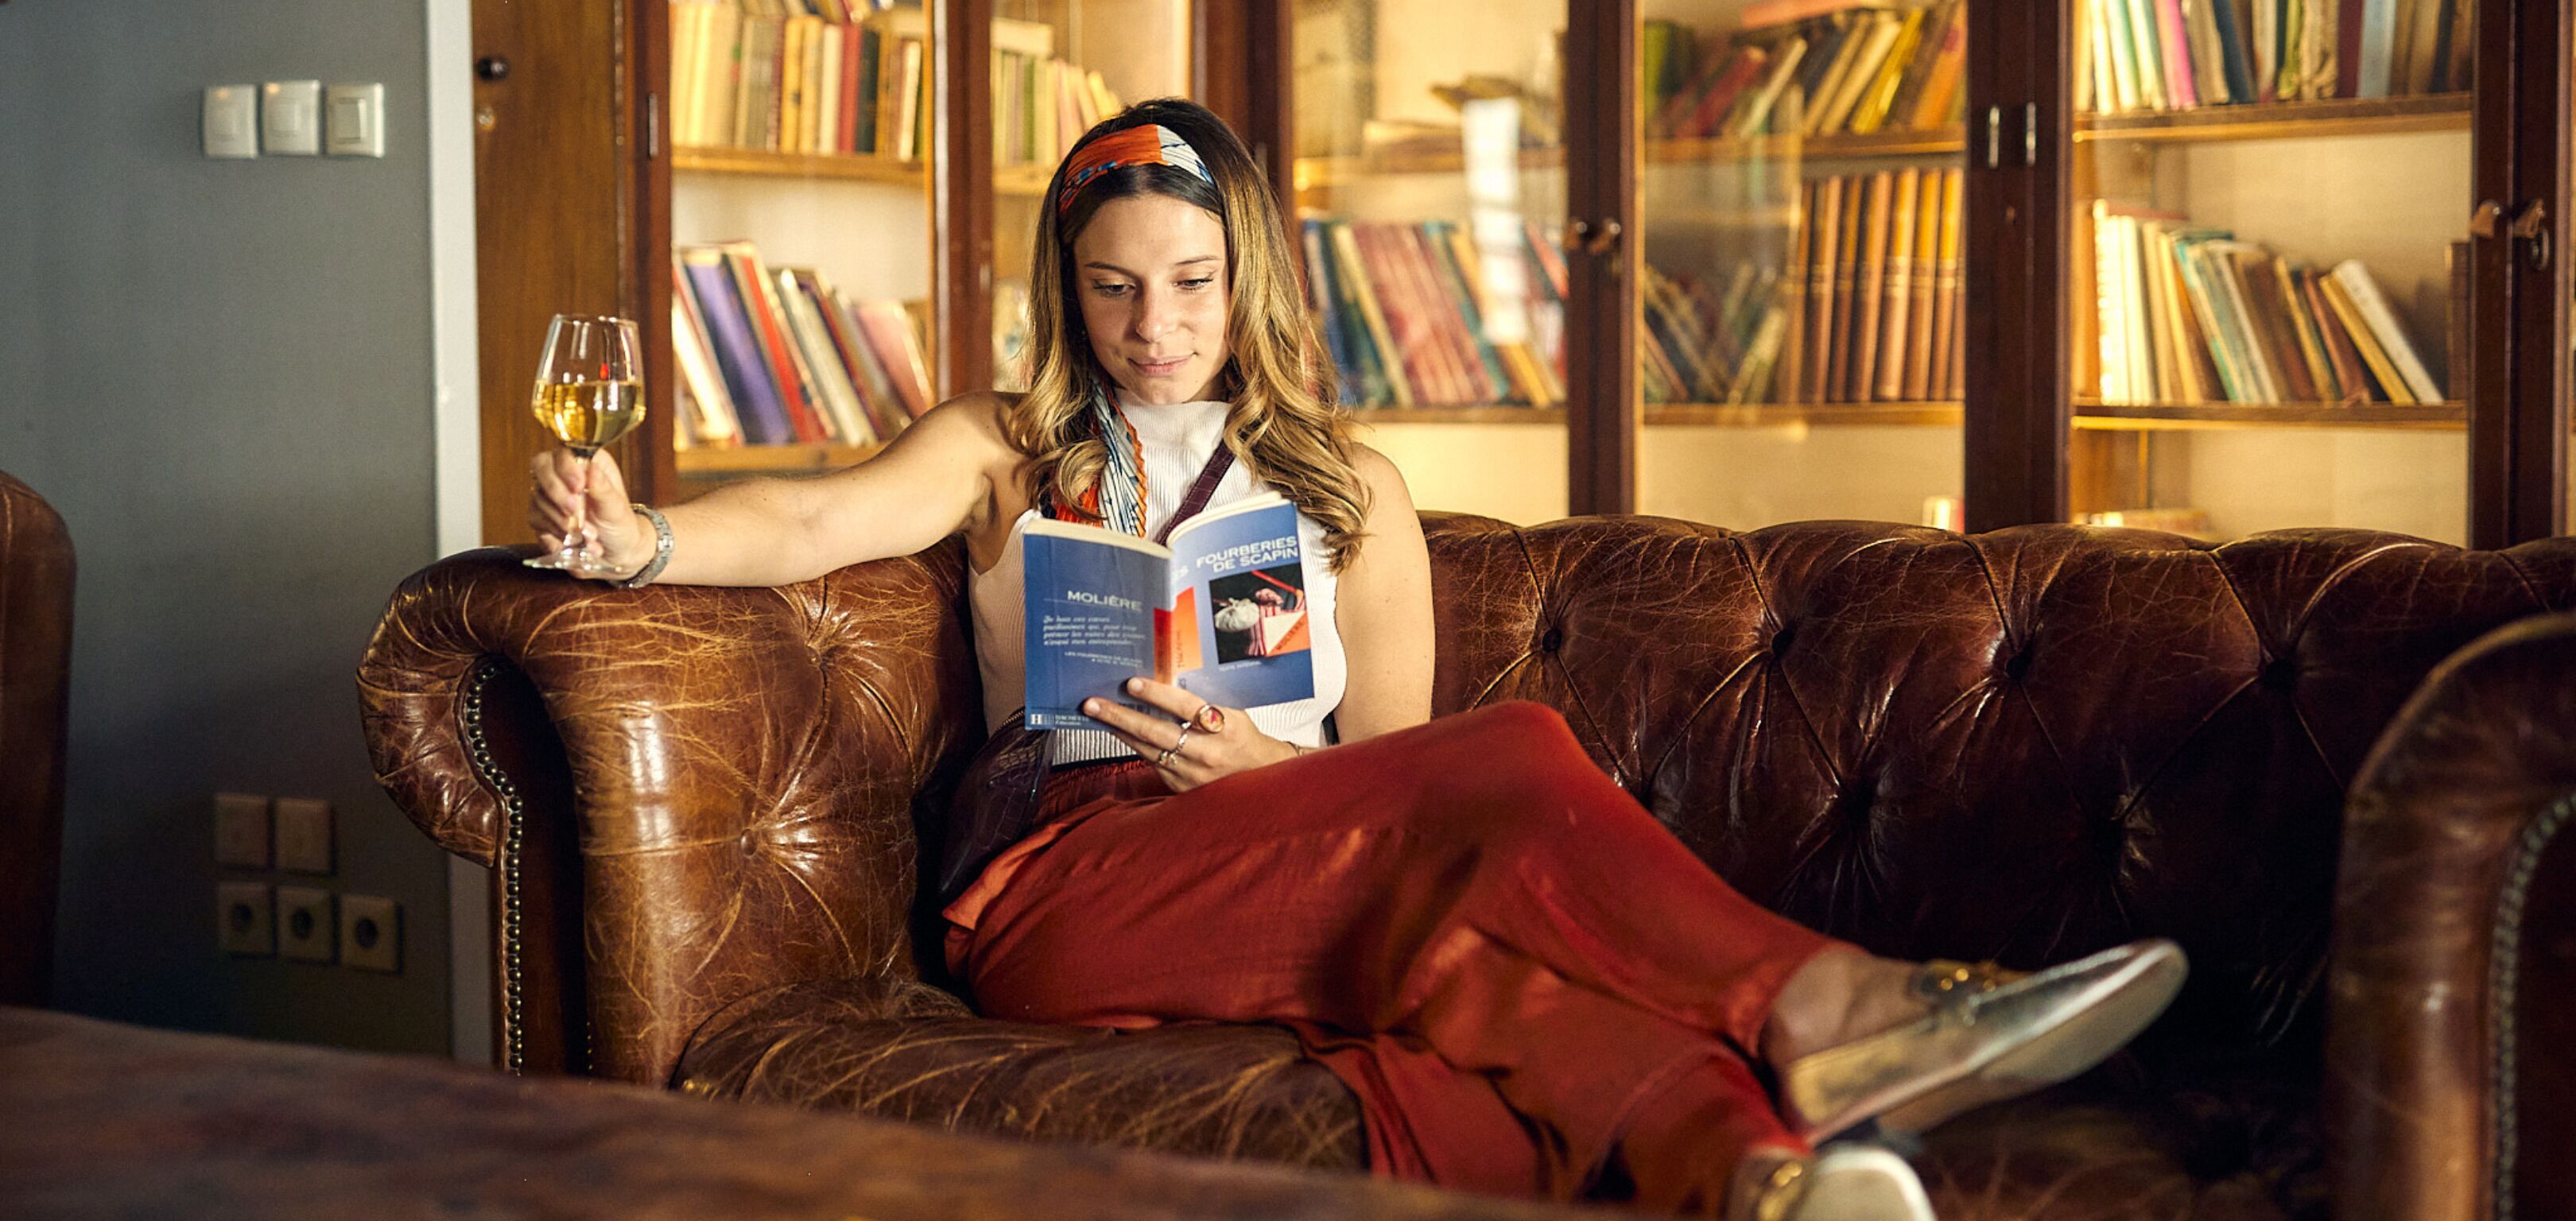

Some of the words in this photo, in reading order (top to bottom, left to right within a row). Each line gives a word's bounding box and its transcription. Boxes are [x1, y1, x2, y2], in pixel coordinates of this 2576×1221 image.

[1196, 536, 1298, 568] FOURBERIES
[1213, 558, 1236, 572] DE
[1240, 547, 1298, 567] SCAPIN
[1067, 590, 1143, 610] MOLIÈRE
